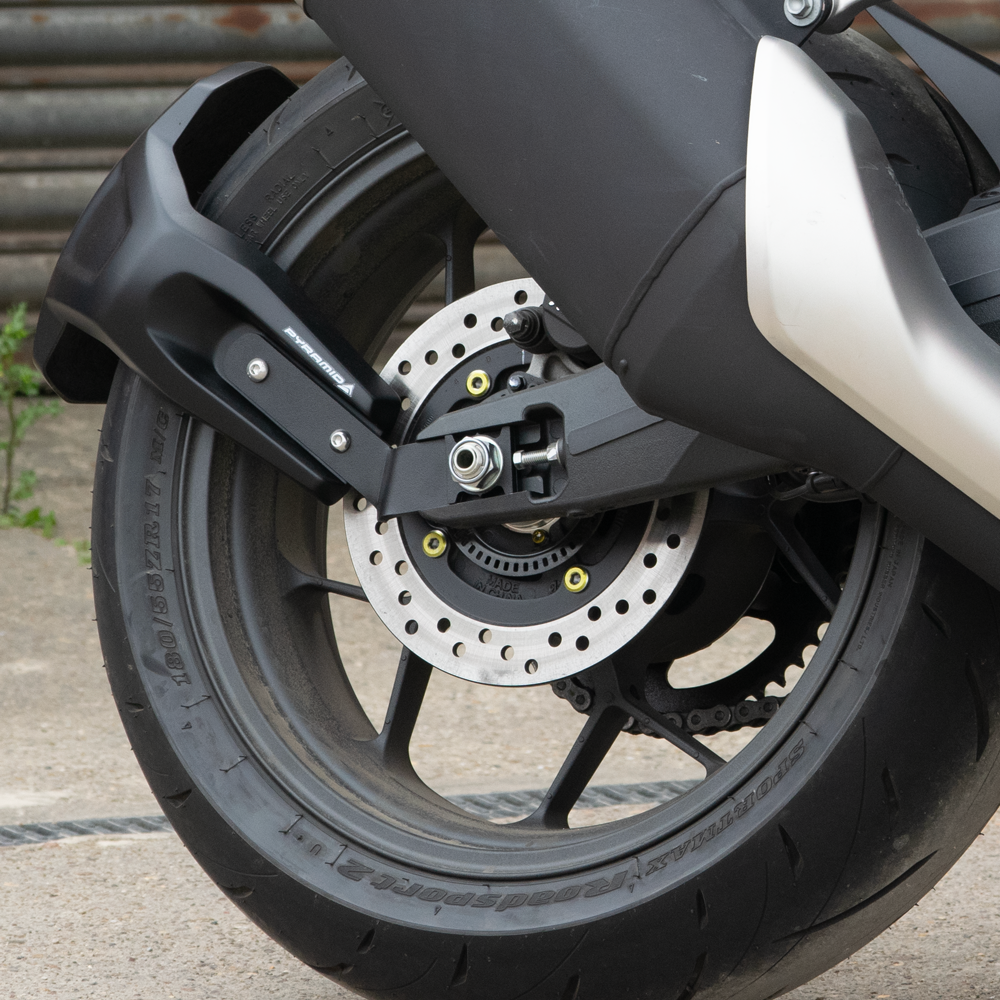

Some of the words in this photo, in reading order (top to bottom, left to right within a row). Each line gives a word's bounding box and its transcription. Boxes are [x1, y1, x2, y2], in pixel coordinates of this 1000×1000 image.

[264, 174, 297, 202] RADIAL
[277, 189, 293, 205] USE
[291, 170, 310, 189] ONLY
[282, 325, 346, 385] PYRAMID
[150, 408, 169, 465] M/C
[143, 478, 191, 687] 180/55ZR17
[486, 574, 520, 594] MADE
[645, 738, 805, 877] SPORTMAX
[336, 858, 375, 883] 2
[370, 870, 628, 912] Roadsport
